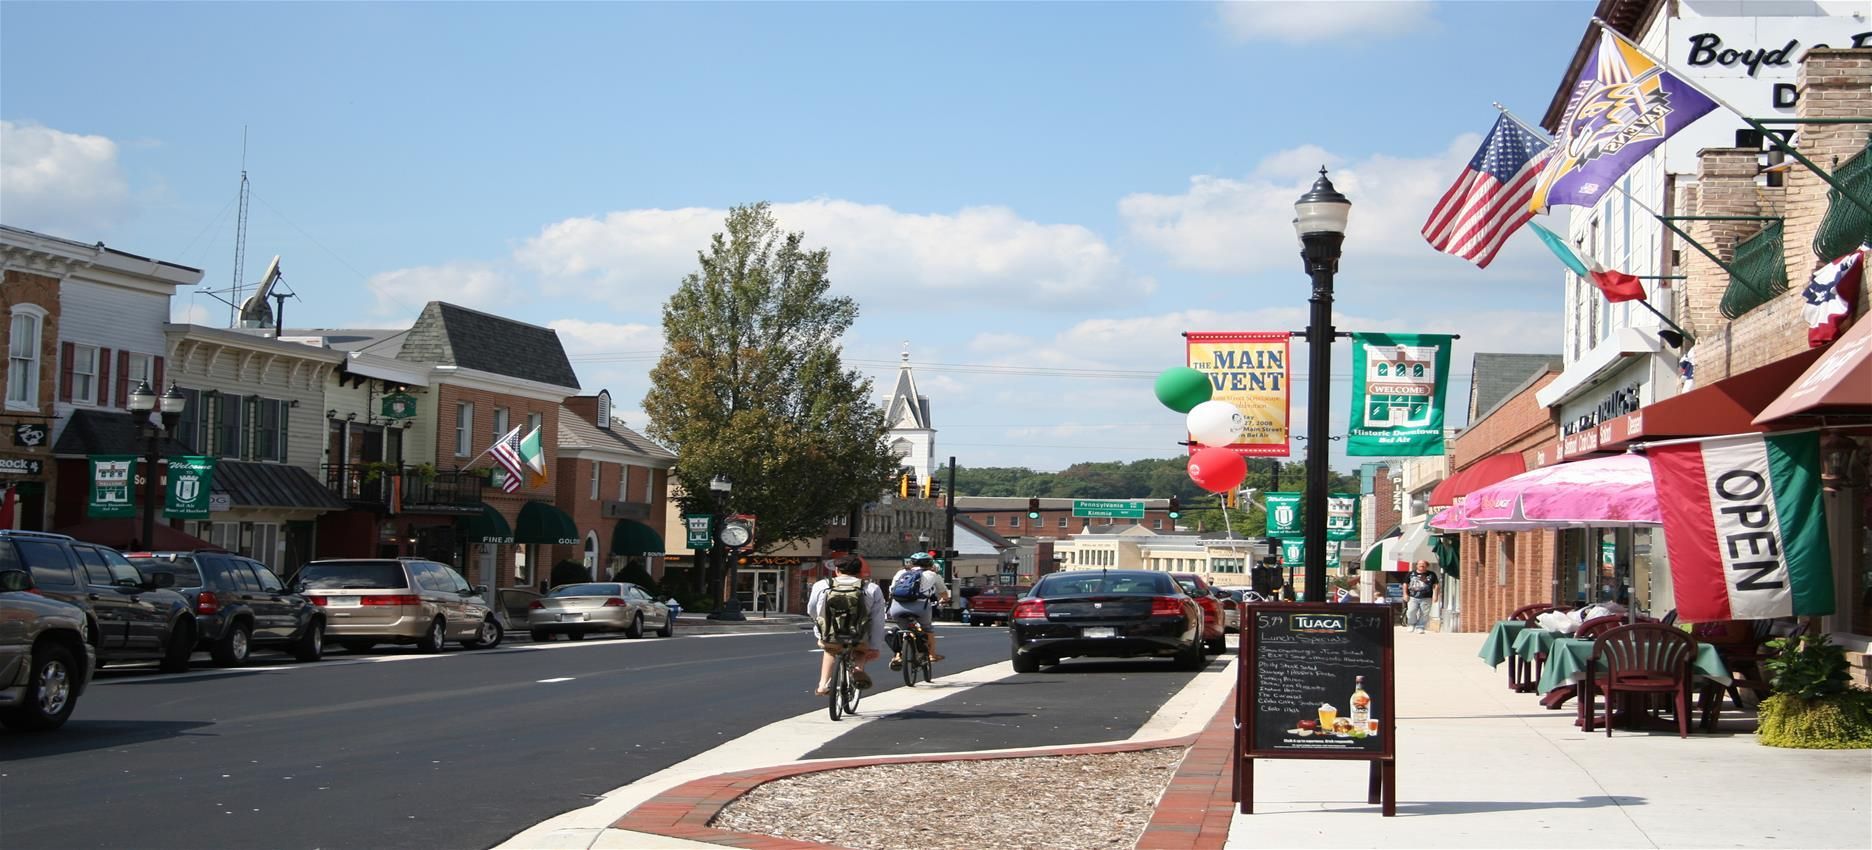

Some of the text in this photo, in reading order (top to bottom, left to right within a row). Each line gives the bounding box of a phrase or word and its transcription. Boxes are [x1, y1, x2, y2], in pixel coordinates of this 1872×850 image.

[1687, 33, 1798, 77] Boyd
[1213, 350, 1284, 369] MAIN
[1205, 372, 1284, 391] VENT
[169, 462, 213, 470] Welcome
[1393, 477, 1402, 512] PIZZA
[1715, 470, 1783, 591] OPEN
[1295, 617, 1341, 628] TUACA
[1261, 632, 1350, 644] Lunch Specials
